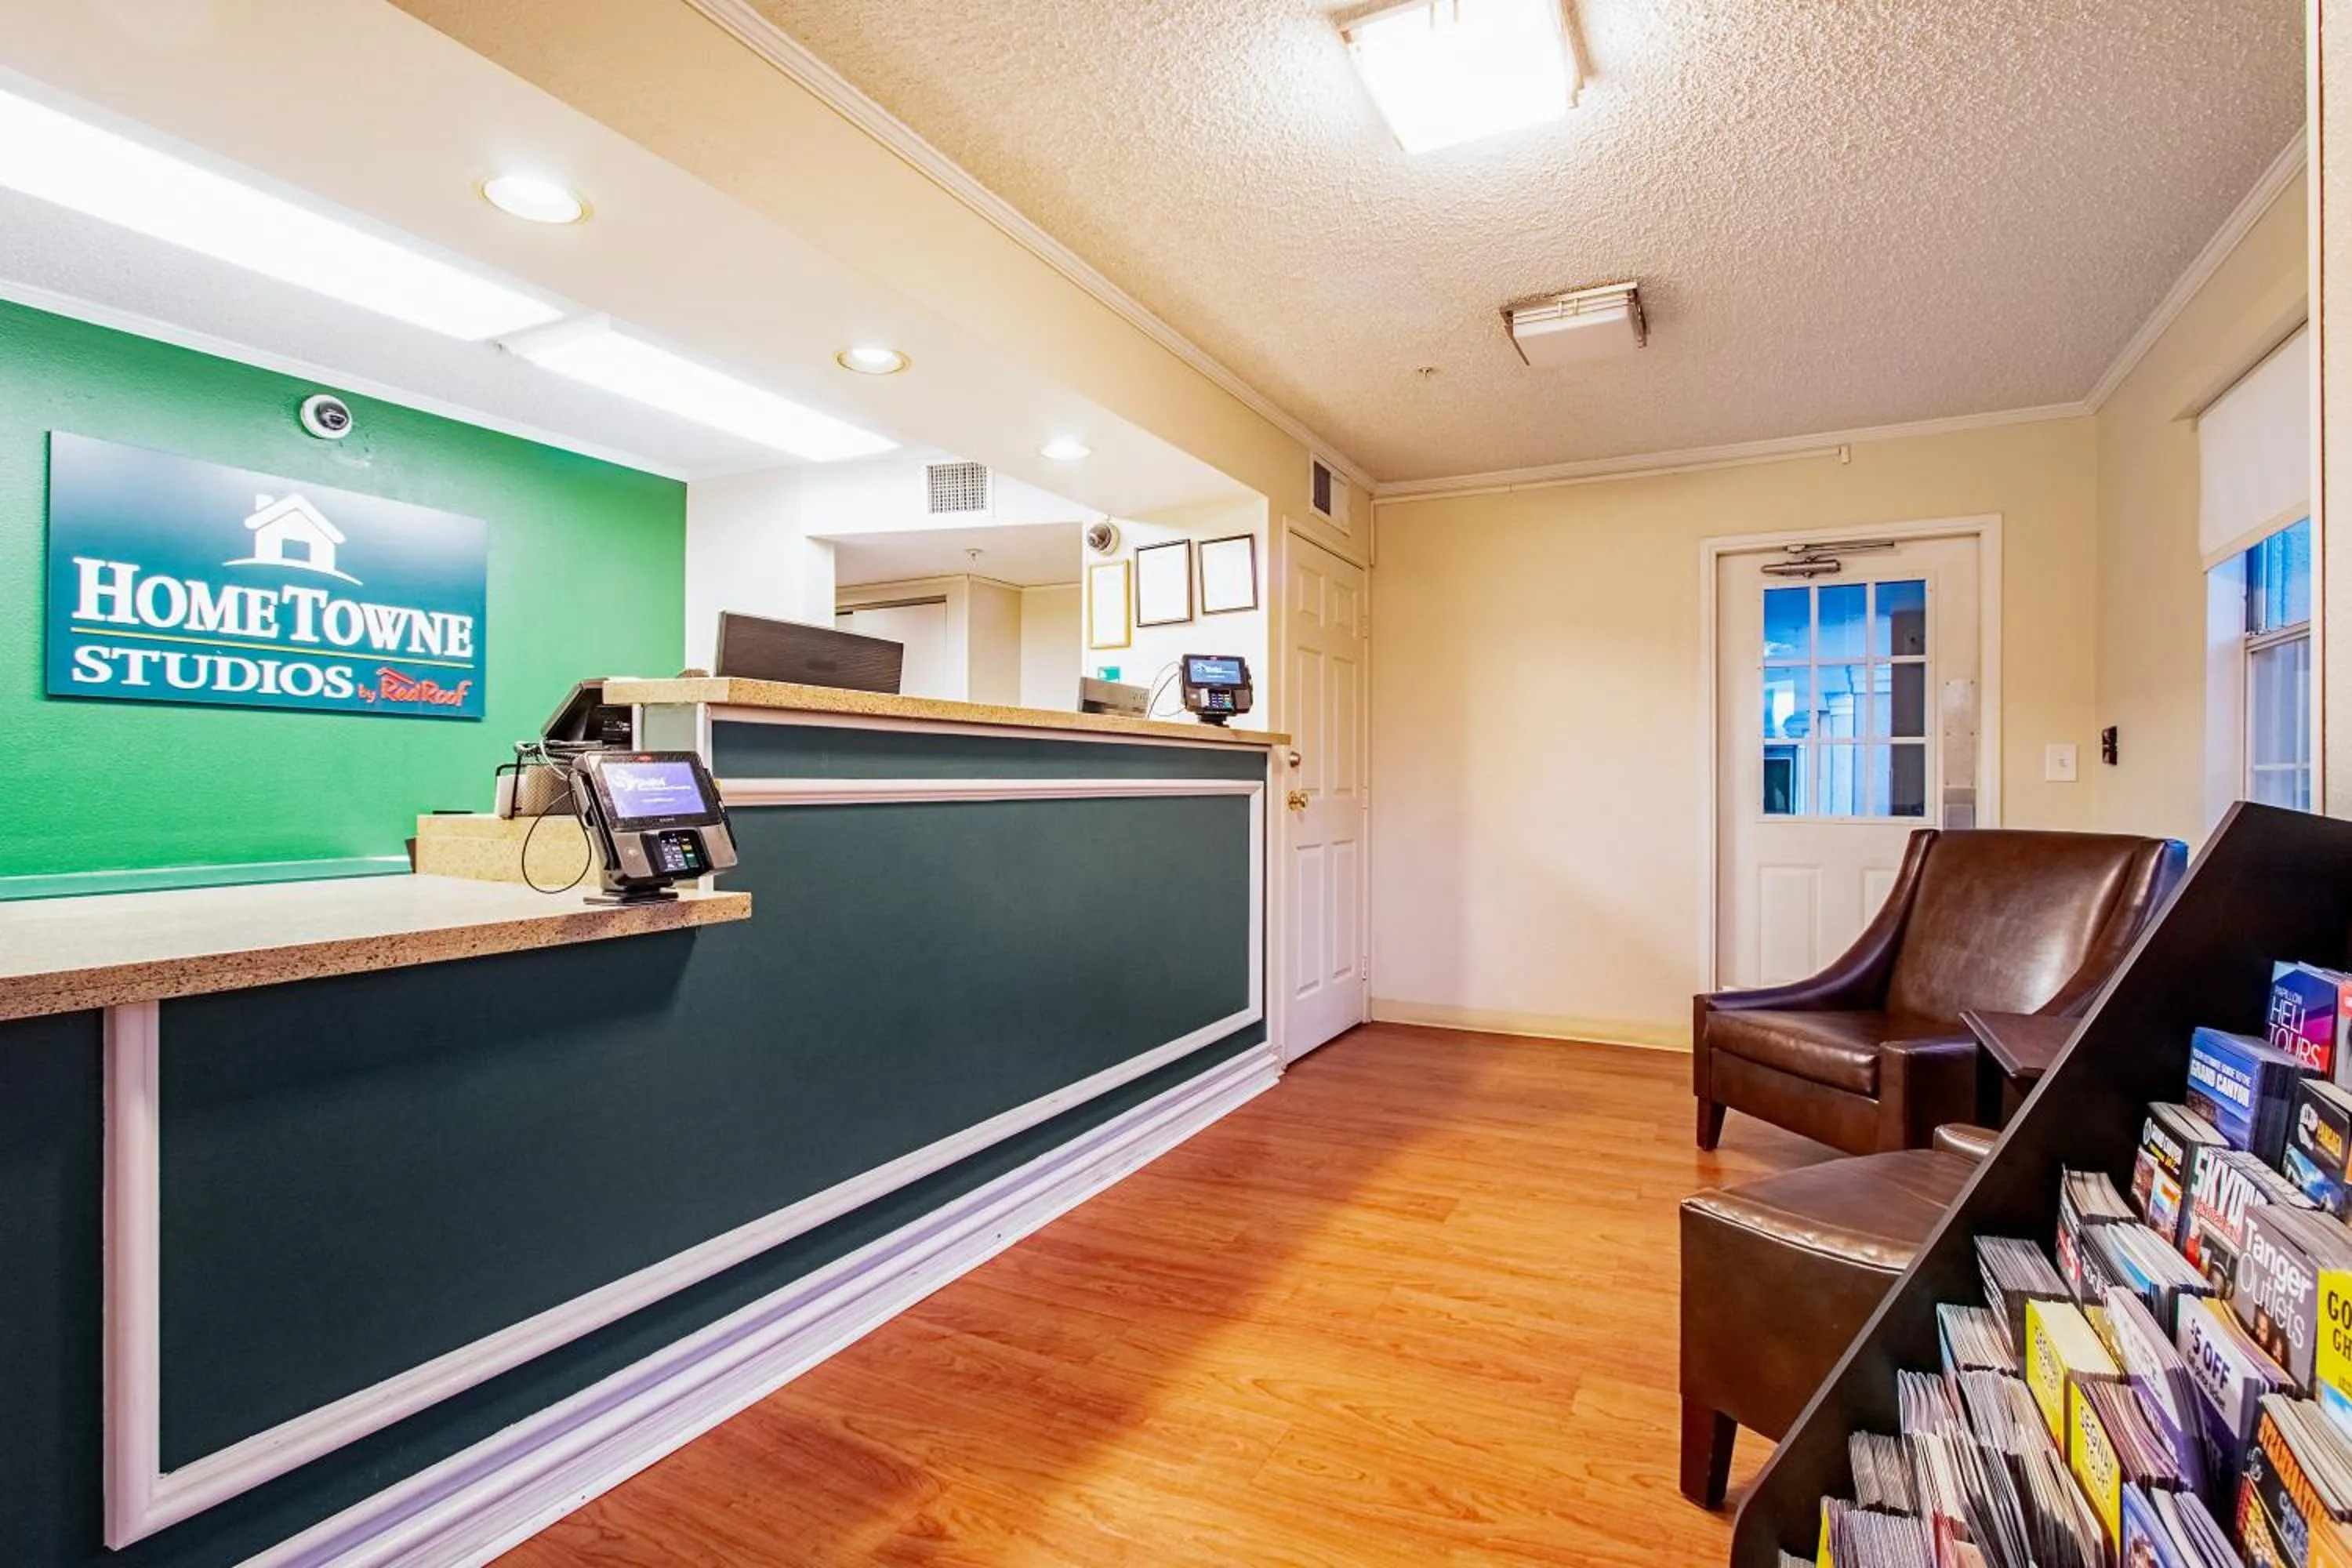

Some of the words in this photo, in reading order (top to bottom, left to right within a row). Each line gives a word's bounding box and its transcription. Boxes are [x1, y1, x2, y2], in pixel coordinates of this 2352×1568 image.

[72, 645, 354, 699] STUDIOS
[358, 683, 376, 703] by
[2270, 996, 2306, 1036] HELI
[2269, 1022, 2321, 1068] TOURS
[2190, 1058, 2216, 1088] GRAND
[2216, 1073, 2250, 1109] CANYON
[2245, 1216, 2314, 1304] Tanger
[2239, 1252, 2305, 1349] Outlets
[2204, 1340, 2230, 1389] OFF
